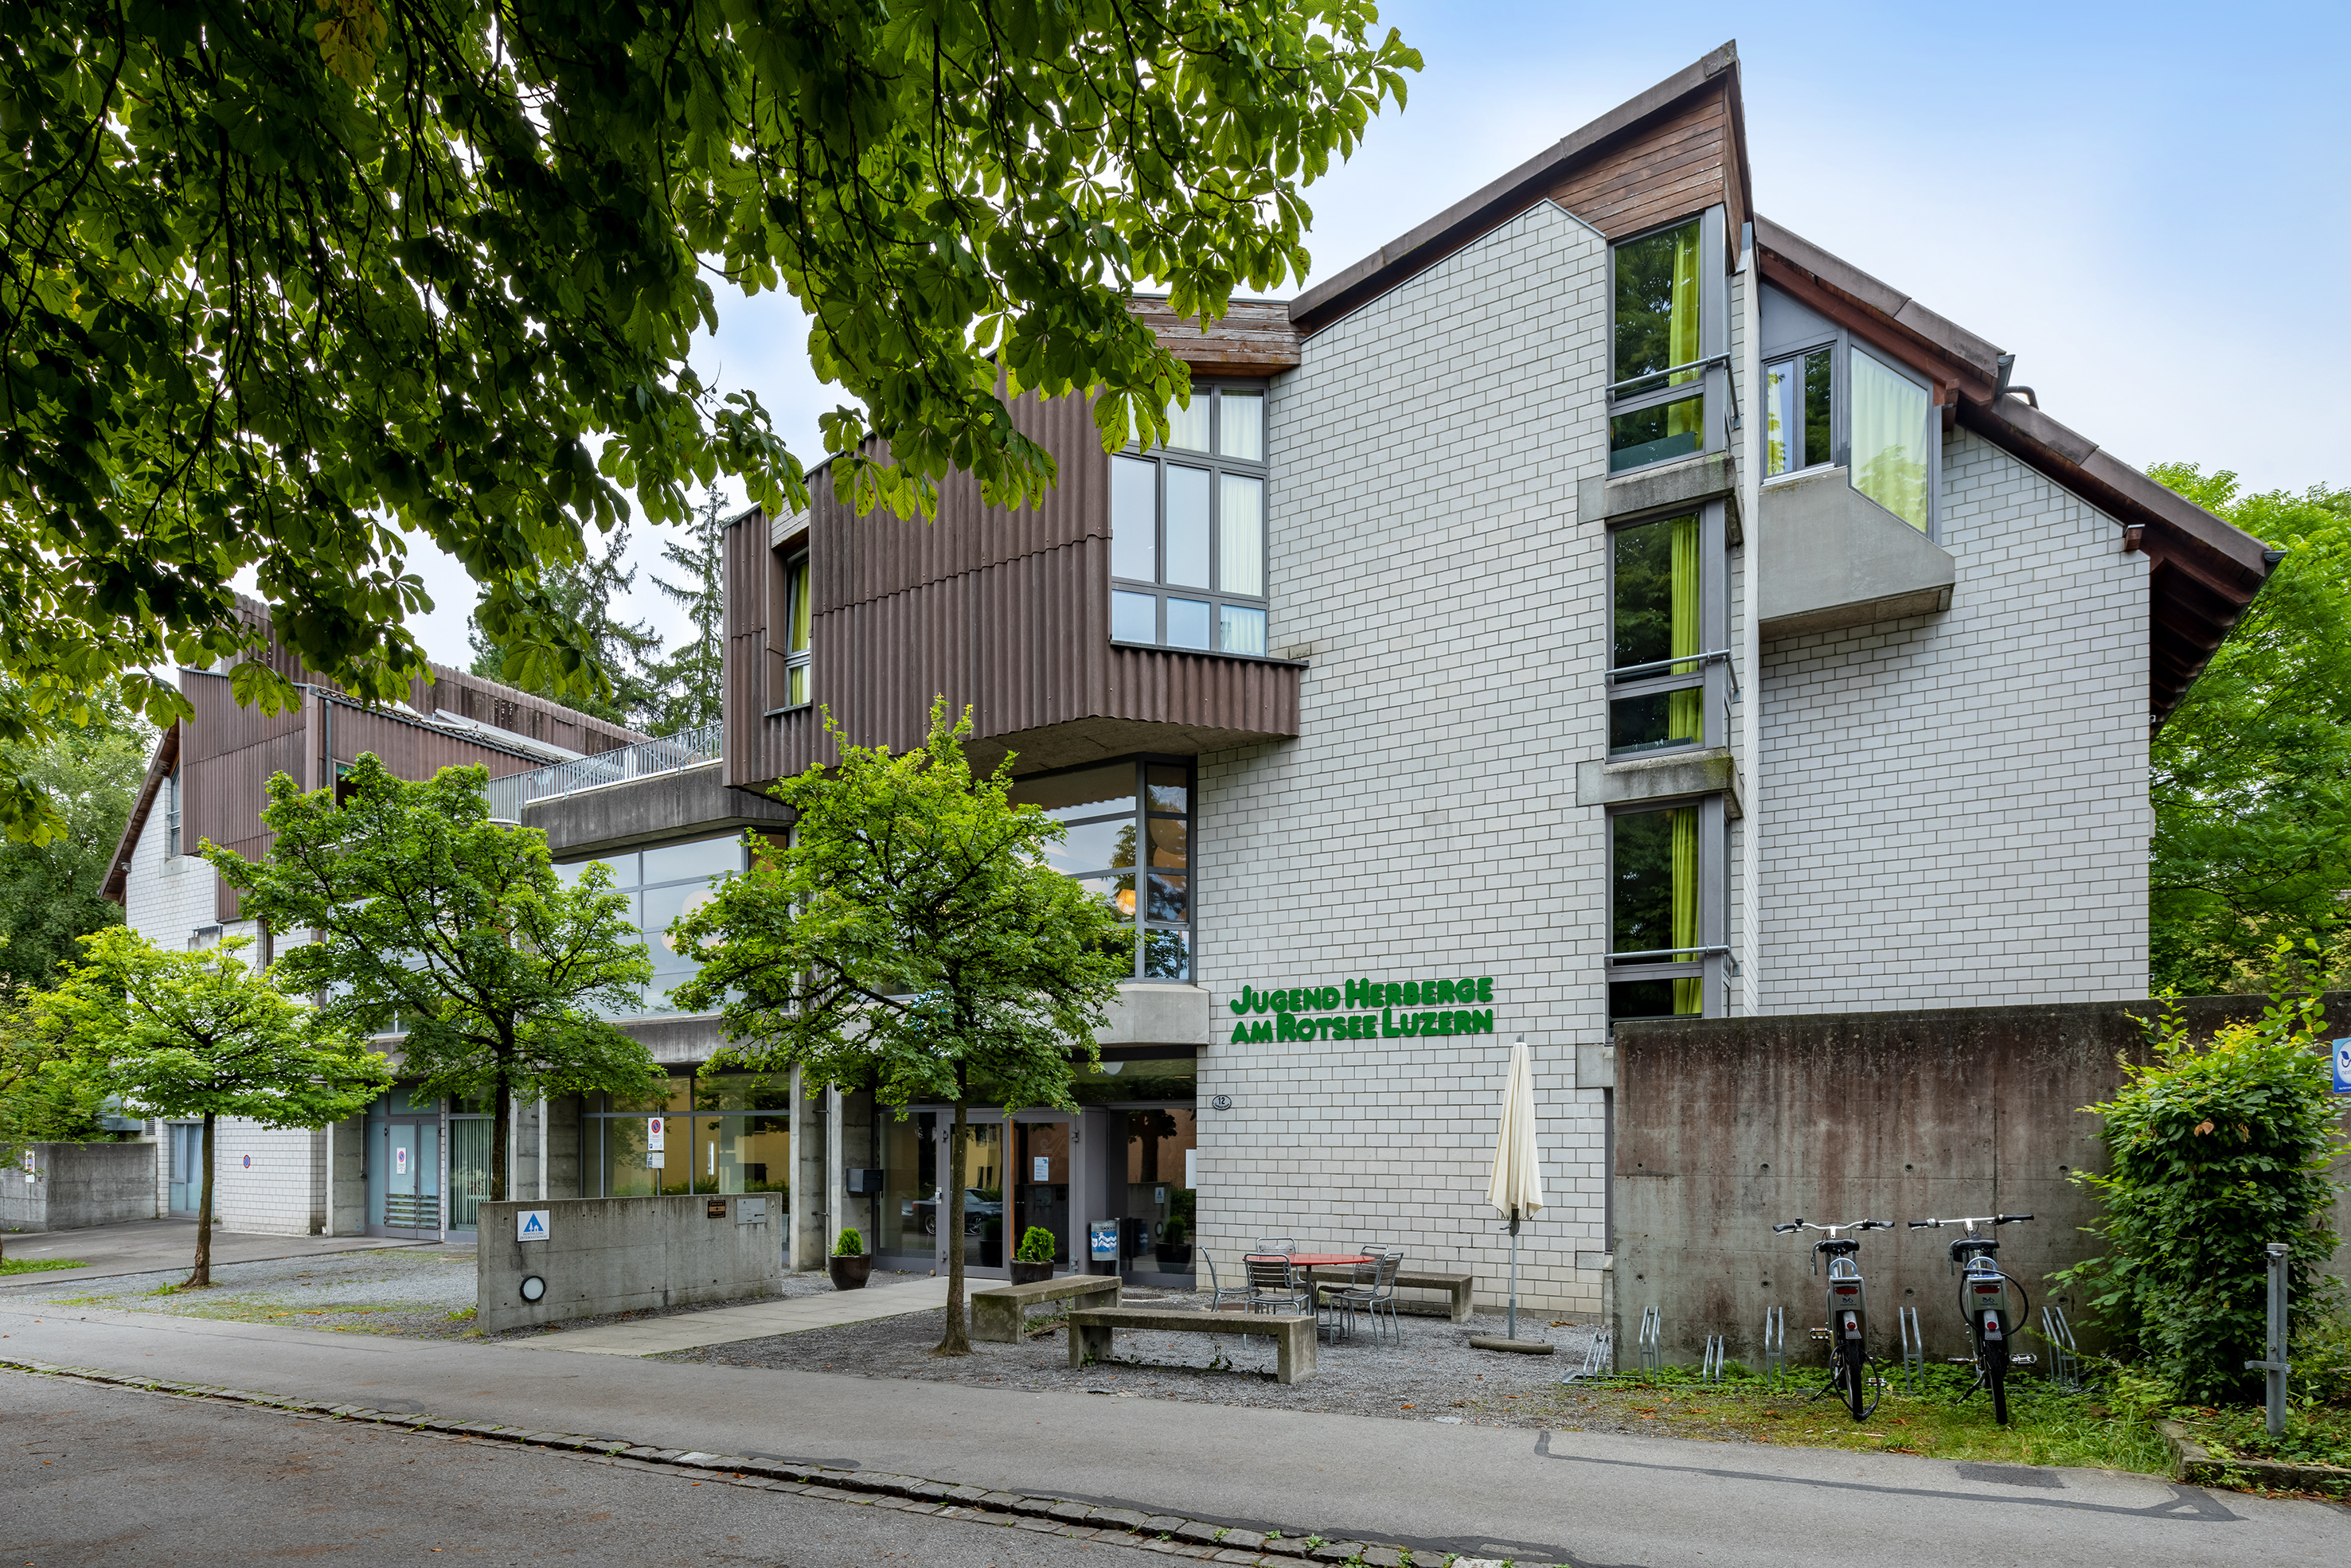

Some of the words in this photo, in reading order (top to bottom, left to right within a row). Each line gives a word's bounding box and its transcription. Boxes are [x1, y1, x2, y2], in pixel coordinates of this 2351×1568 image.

[1230, 985, 1341, 1015] JUGEND
[1345, 977, 1494, 1009] HERBERGE
[1276, 1012, 1377, 1042] ROTSEE
[1382, 1007, 1494, 1038] LUZERN
